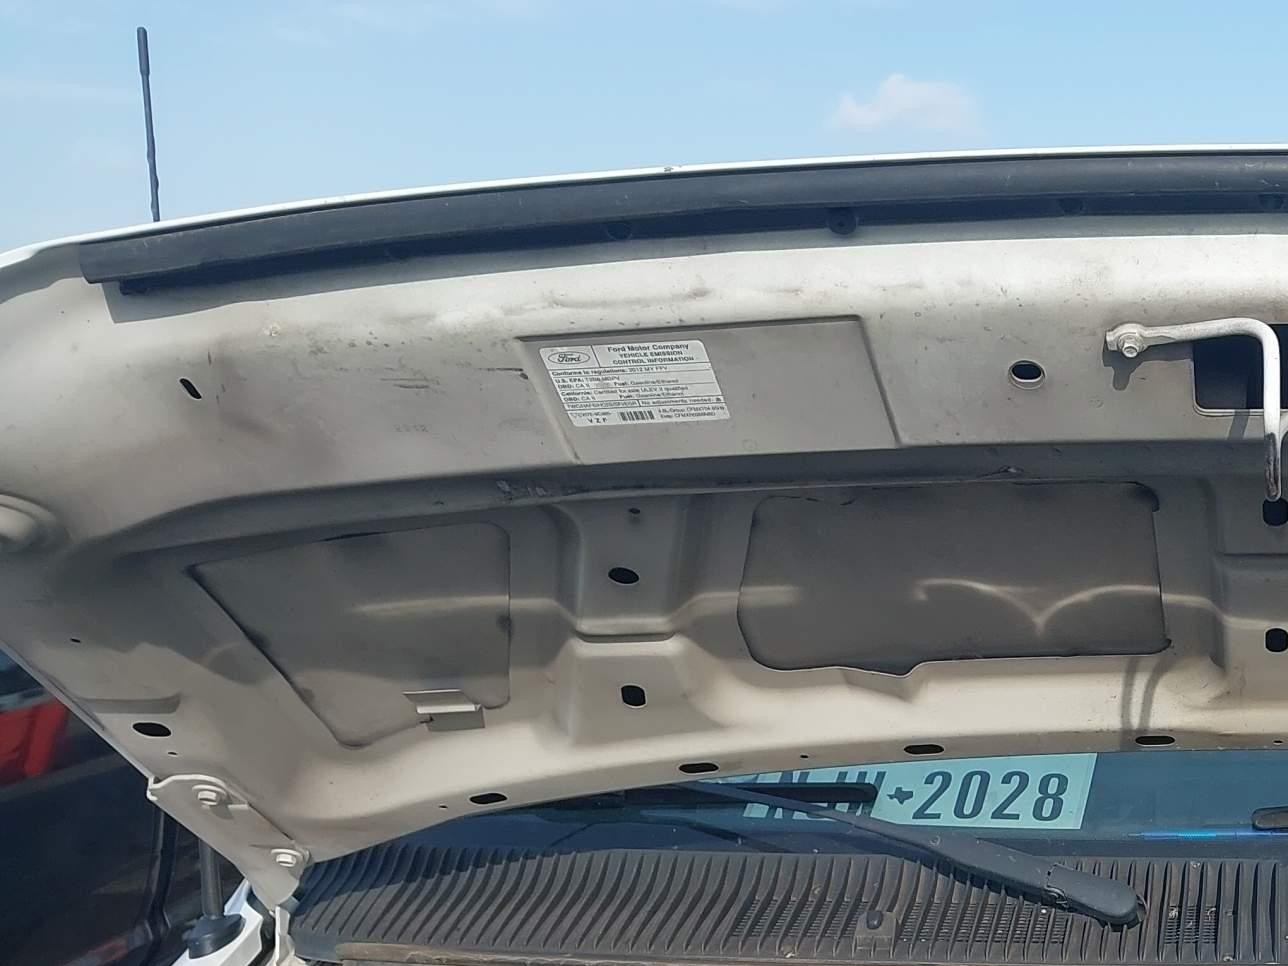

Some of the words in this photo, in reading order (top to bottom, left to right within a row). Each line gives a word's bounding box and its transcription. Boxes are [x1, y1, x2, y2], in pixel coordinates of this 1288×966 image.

[652, 343, 689, 352] Company
[557, 352, 582, 363] Ford
[912, 770, 1070, 822] 2028
